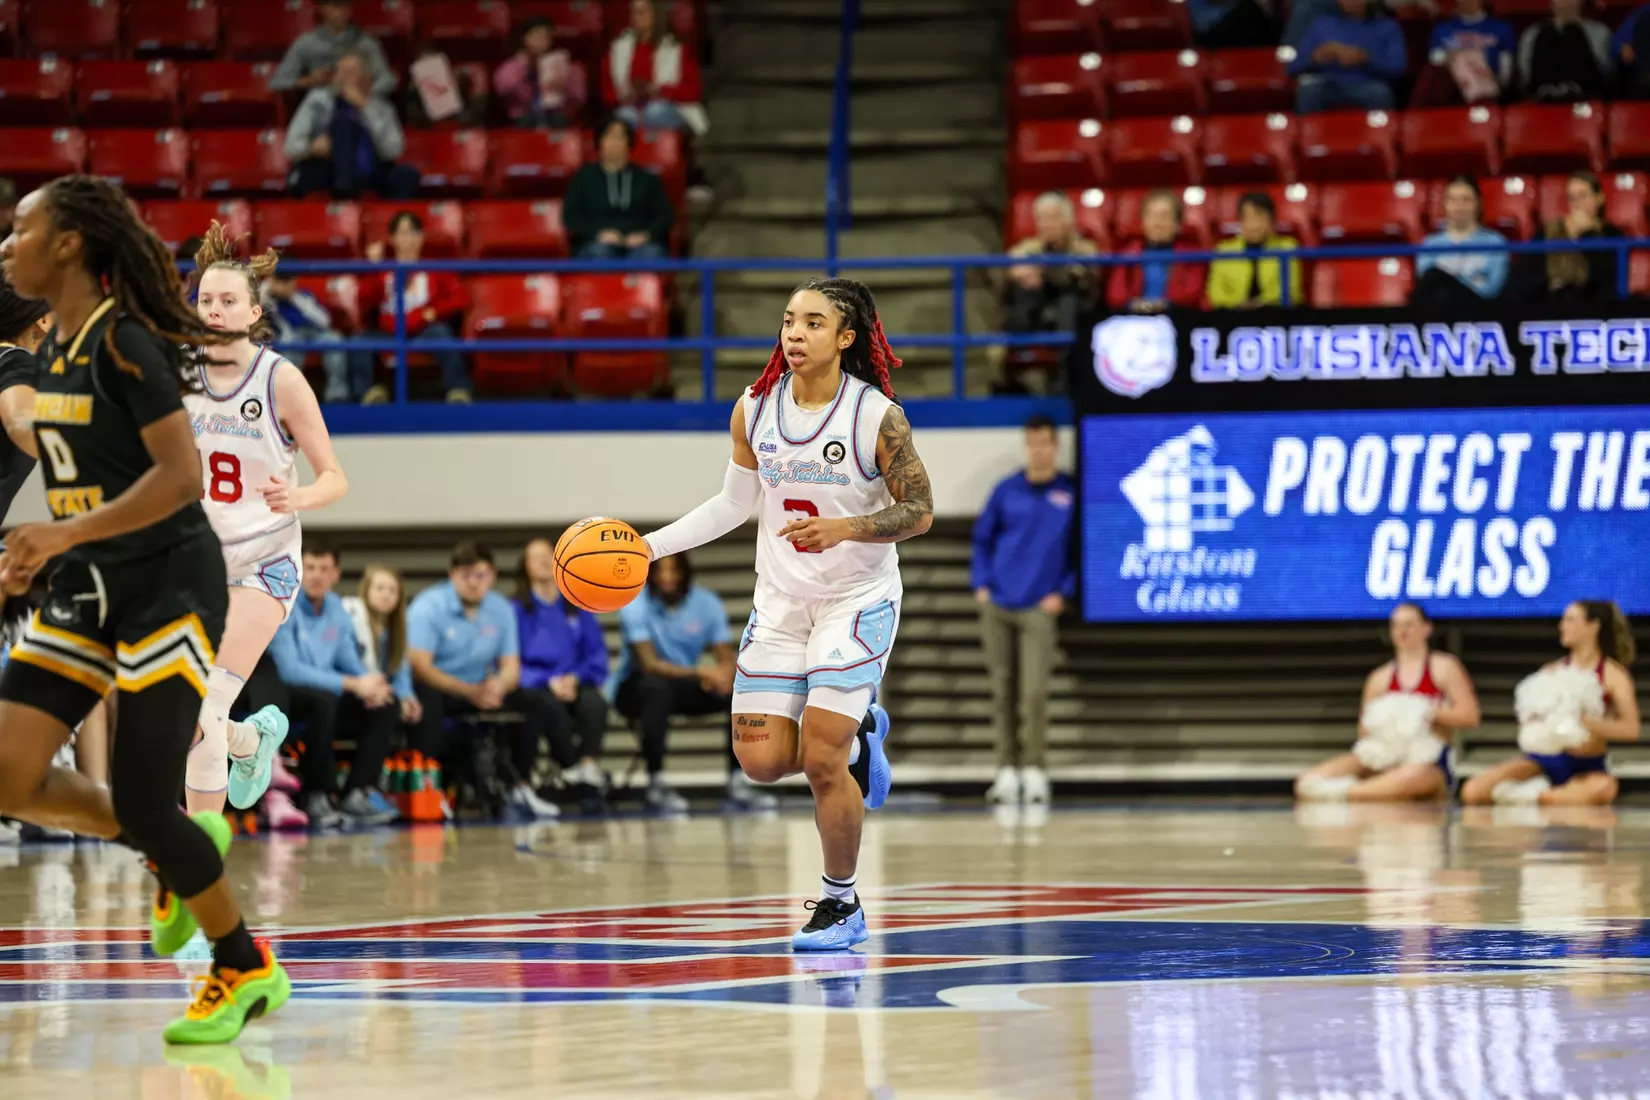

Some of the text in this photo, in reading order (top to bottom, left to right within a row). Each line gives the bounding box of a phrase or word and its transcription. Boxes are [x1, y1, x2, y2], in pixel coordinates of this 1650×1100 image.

[1191, 323, 1516, 382] LOUISIANA
[200, 451, 243, 504] 8
[758, 458, 851, 488] Lady Techsters
[1264, 430, 1650, 516] PROTECT THE
[1366, 517, 1557, 600] GLASS
